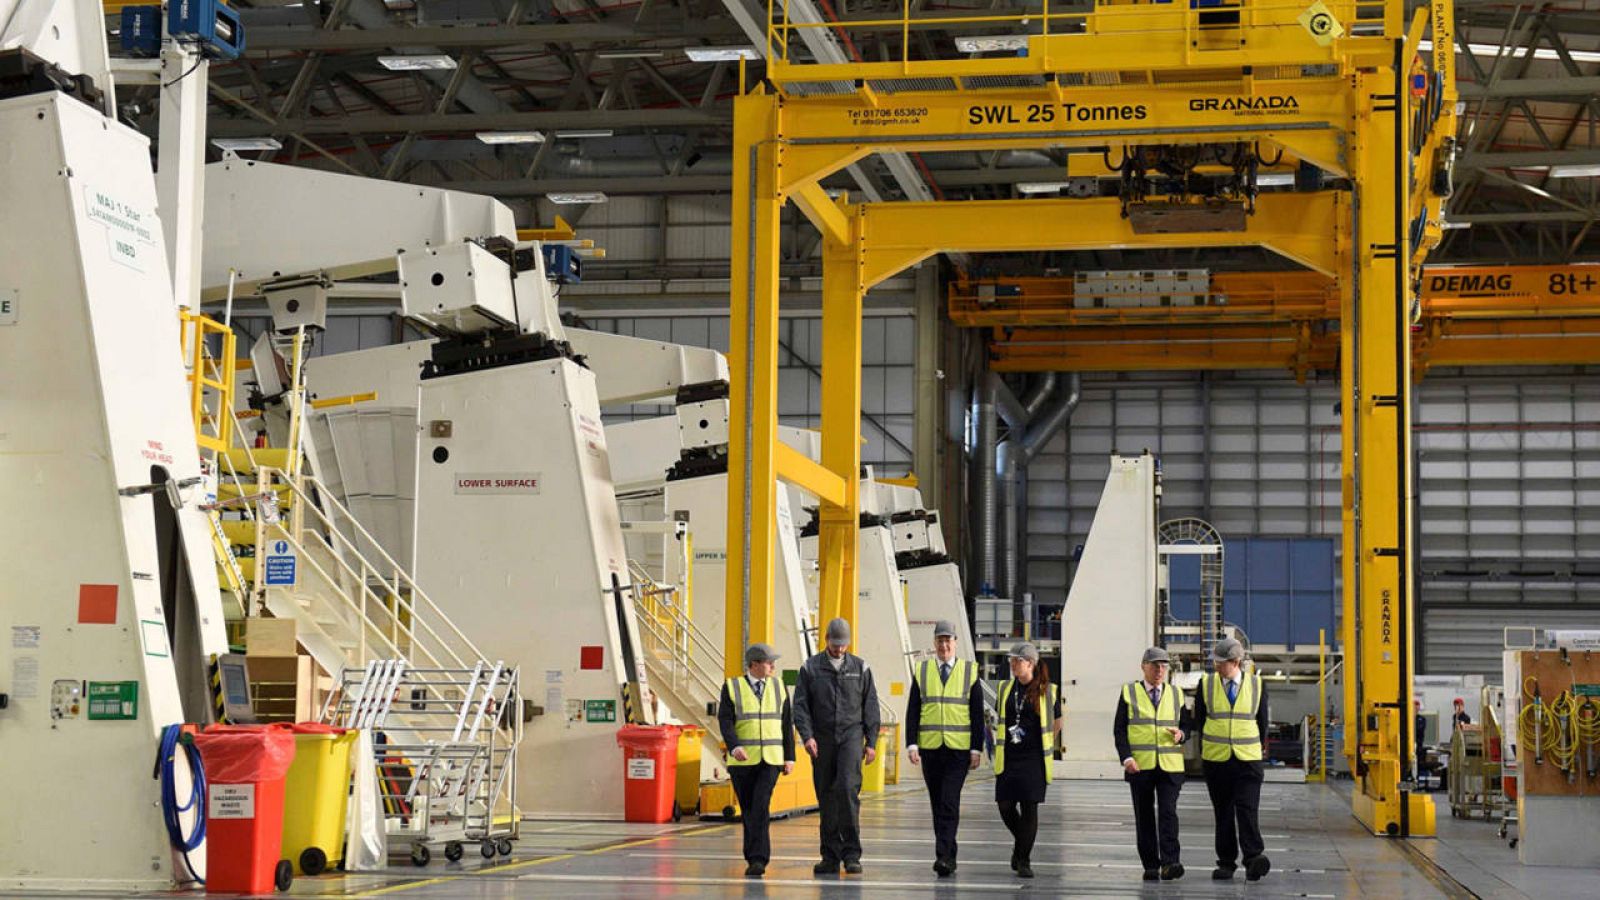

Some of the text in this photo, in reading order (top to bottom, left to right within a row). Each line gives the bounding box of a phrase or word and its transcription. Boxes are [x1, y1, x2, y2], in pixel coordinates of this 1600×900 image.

[1189, 95, 1299, 111] GRANADA
[848, 109, 861, 118] Tel
[863, 109, 891, 118] 01706
[969, 103, 1147, 125] SWL 25 Tonnes
[1431, 275, 1512, 292] DEMAG
[1382, 590, 1391, 644] GRANADA
